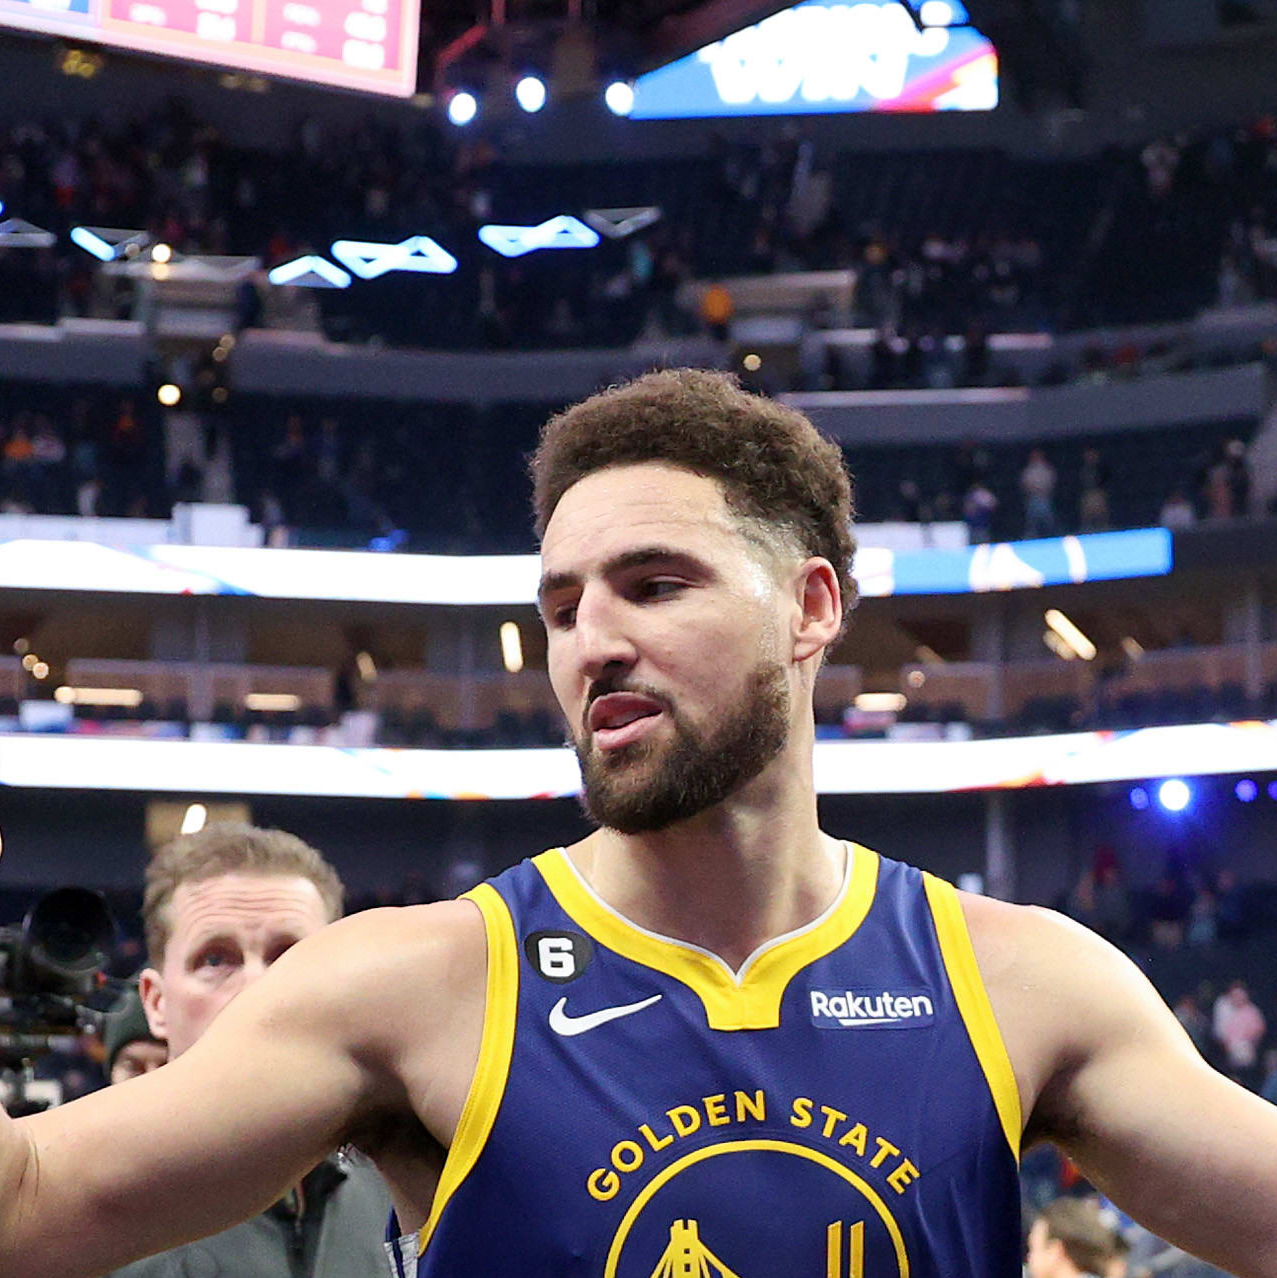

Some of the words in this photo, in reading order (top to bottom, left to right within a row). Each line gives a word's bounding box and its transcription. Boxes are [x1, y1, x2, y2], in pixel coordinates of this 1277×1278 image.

[539, 937, 576, 979] 6
[810, 990, 934, 1020] Rakuten
[586, 1089, 768, 1203] GOLDEN
[789, 1095, 922, 1196] STATE
